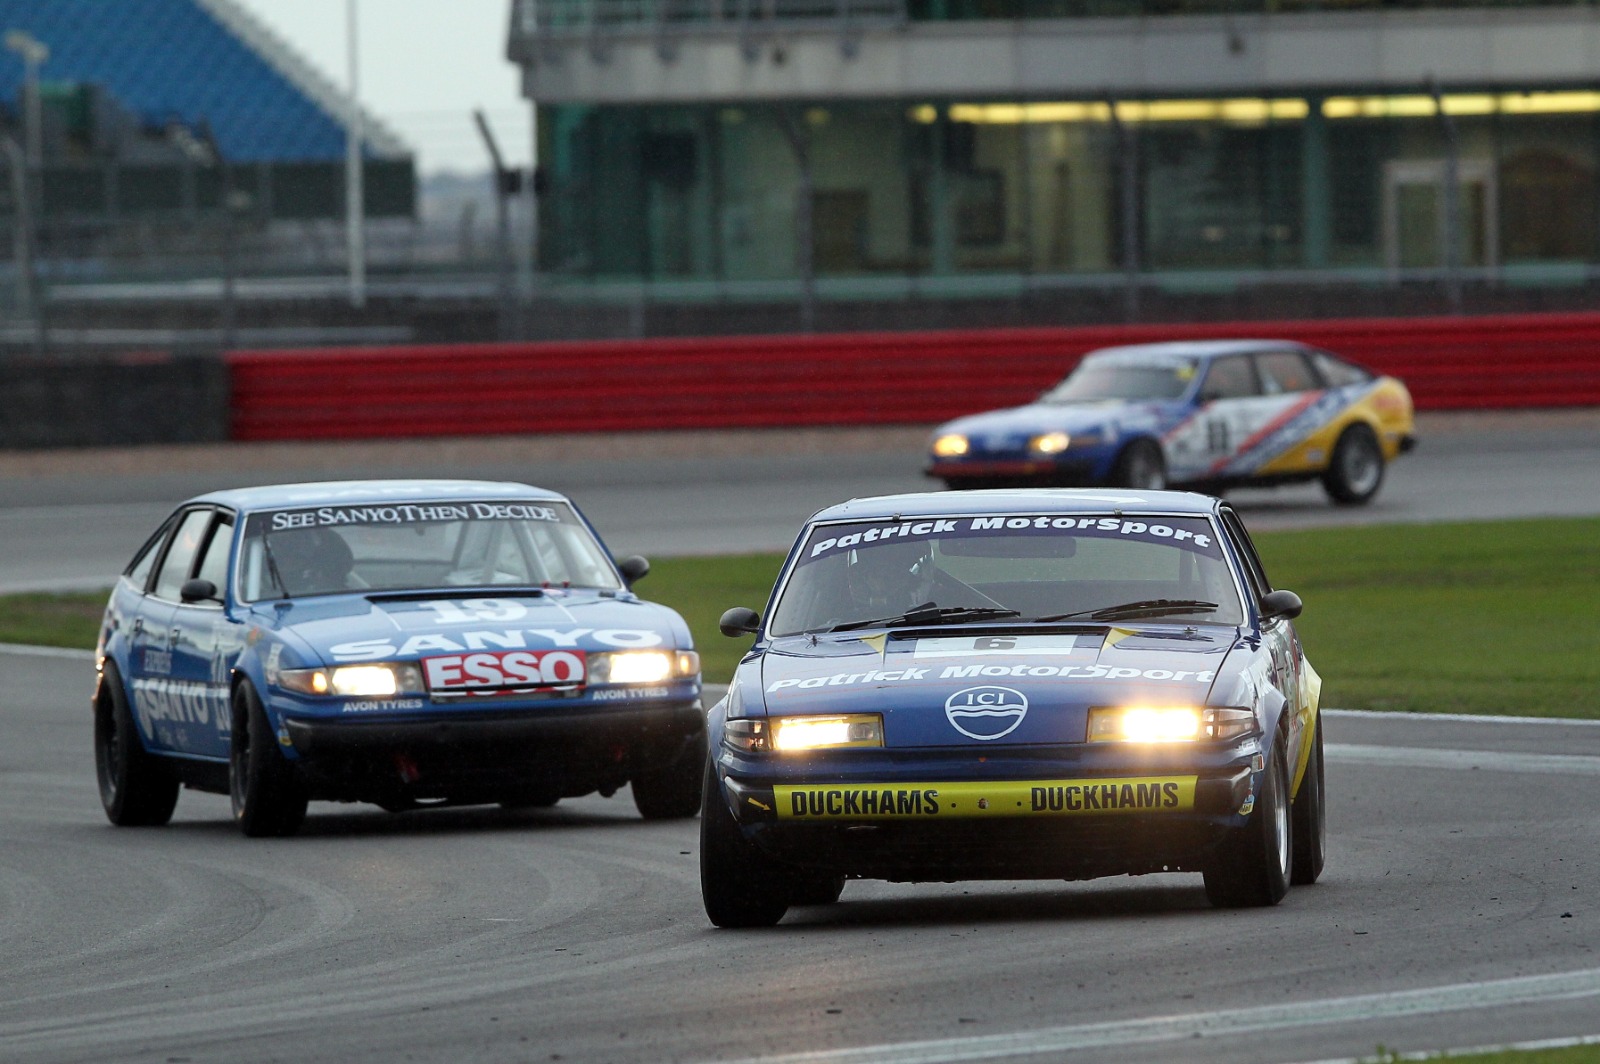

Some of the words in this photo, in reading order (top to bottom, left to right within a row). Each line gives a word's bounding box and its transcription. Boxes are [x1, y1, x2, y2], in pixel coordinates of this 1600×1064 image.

[470, 502, 560, 523] DECIDE
[419, 598, 528, 624] 19
[329, 628, 663, 662] SANYO
[971, 636, 1018, 651] 6
[424, 651, 585, 695] ESSO
[766, 664, 932, 693] Patrick
[145, 678, 209, 725] SANYO
[342, 701, 379, 713] AVON
[380, 698, 423, 711] TYRES
[592, 689, 627, 701] AVON
[628, 686, 669, 698] TYRES
[966, 692, 1006, 706] ICI
[791, 789, 940, 816] DUCKHAMS
[1031, 782, 1179, 812] DUCKHAMS
